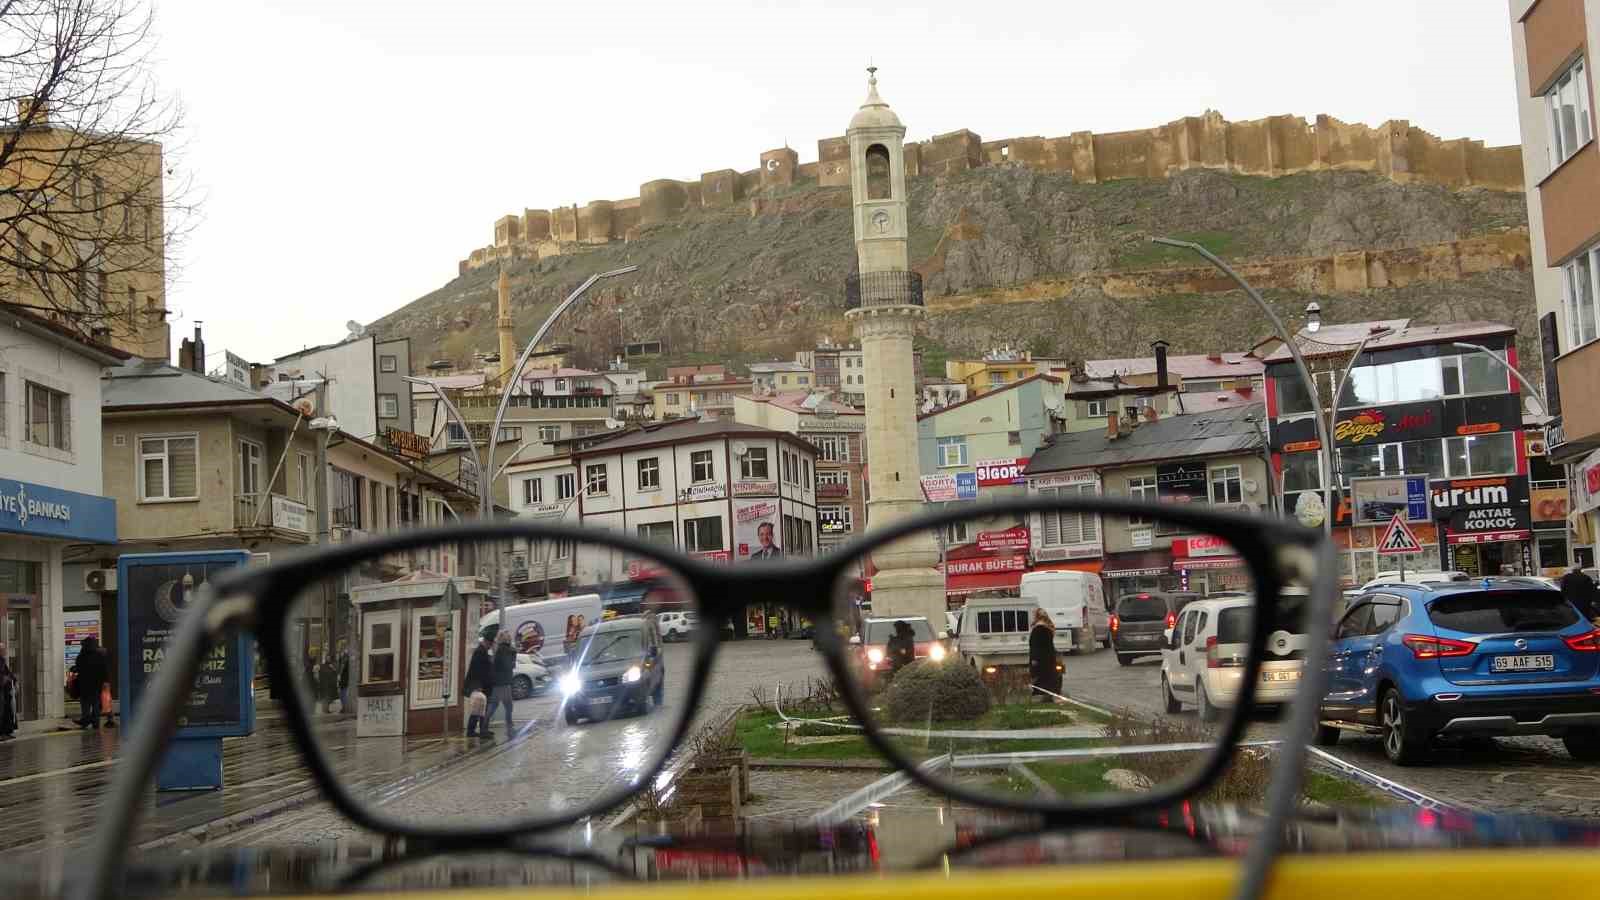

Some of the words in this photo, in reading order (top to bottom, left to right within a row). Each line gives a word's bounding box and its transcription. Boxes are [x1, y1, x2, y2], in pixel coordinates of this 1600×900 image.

[1335, 420, 1385, 442] Burger
[1430, 486, 1509, 508] ürüm
[28, 499, 71, 520] BANKASI
[1468, 508, 1512, 519] AKTAR
[1464, 518, 1516, 530] KOKOÇ
[947, 563, 983, 574] BURAK
[985, 559, 1013, 571] BÜFE
[1496, 658, 1508, 668] 69
[1513, 656, 1529, 667] AAF
[1535, 656, 1552, 667] 515
